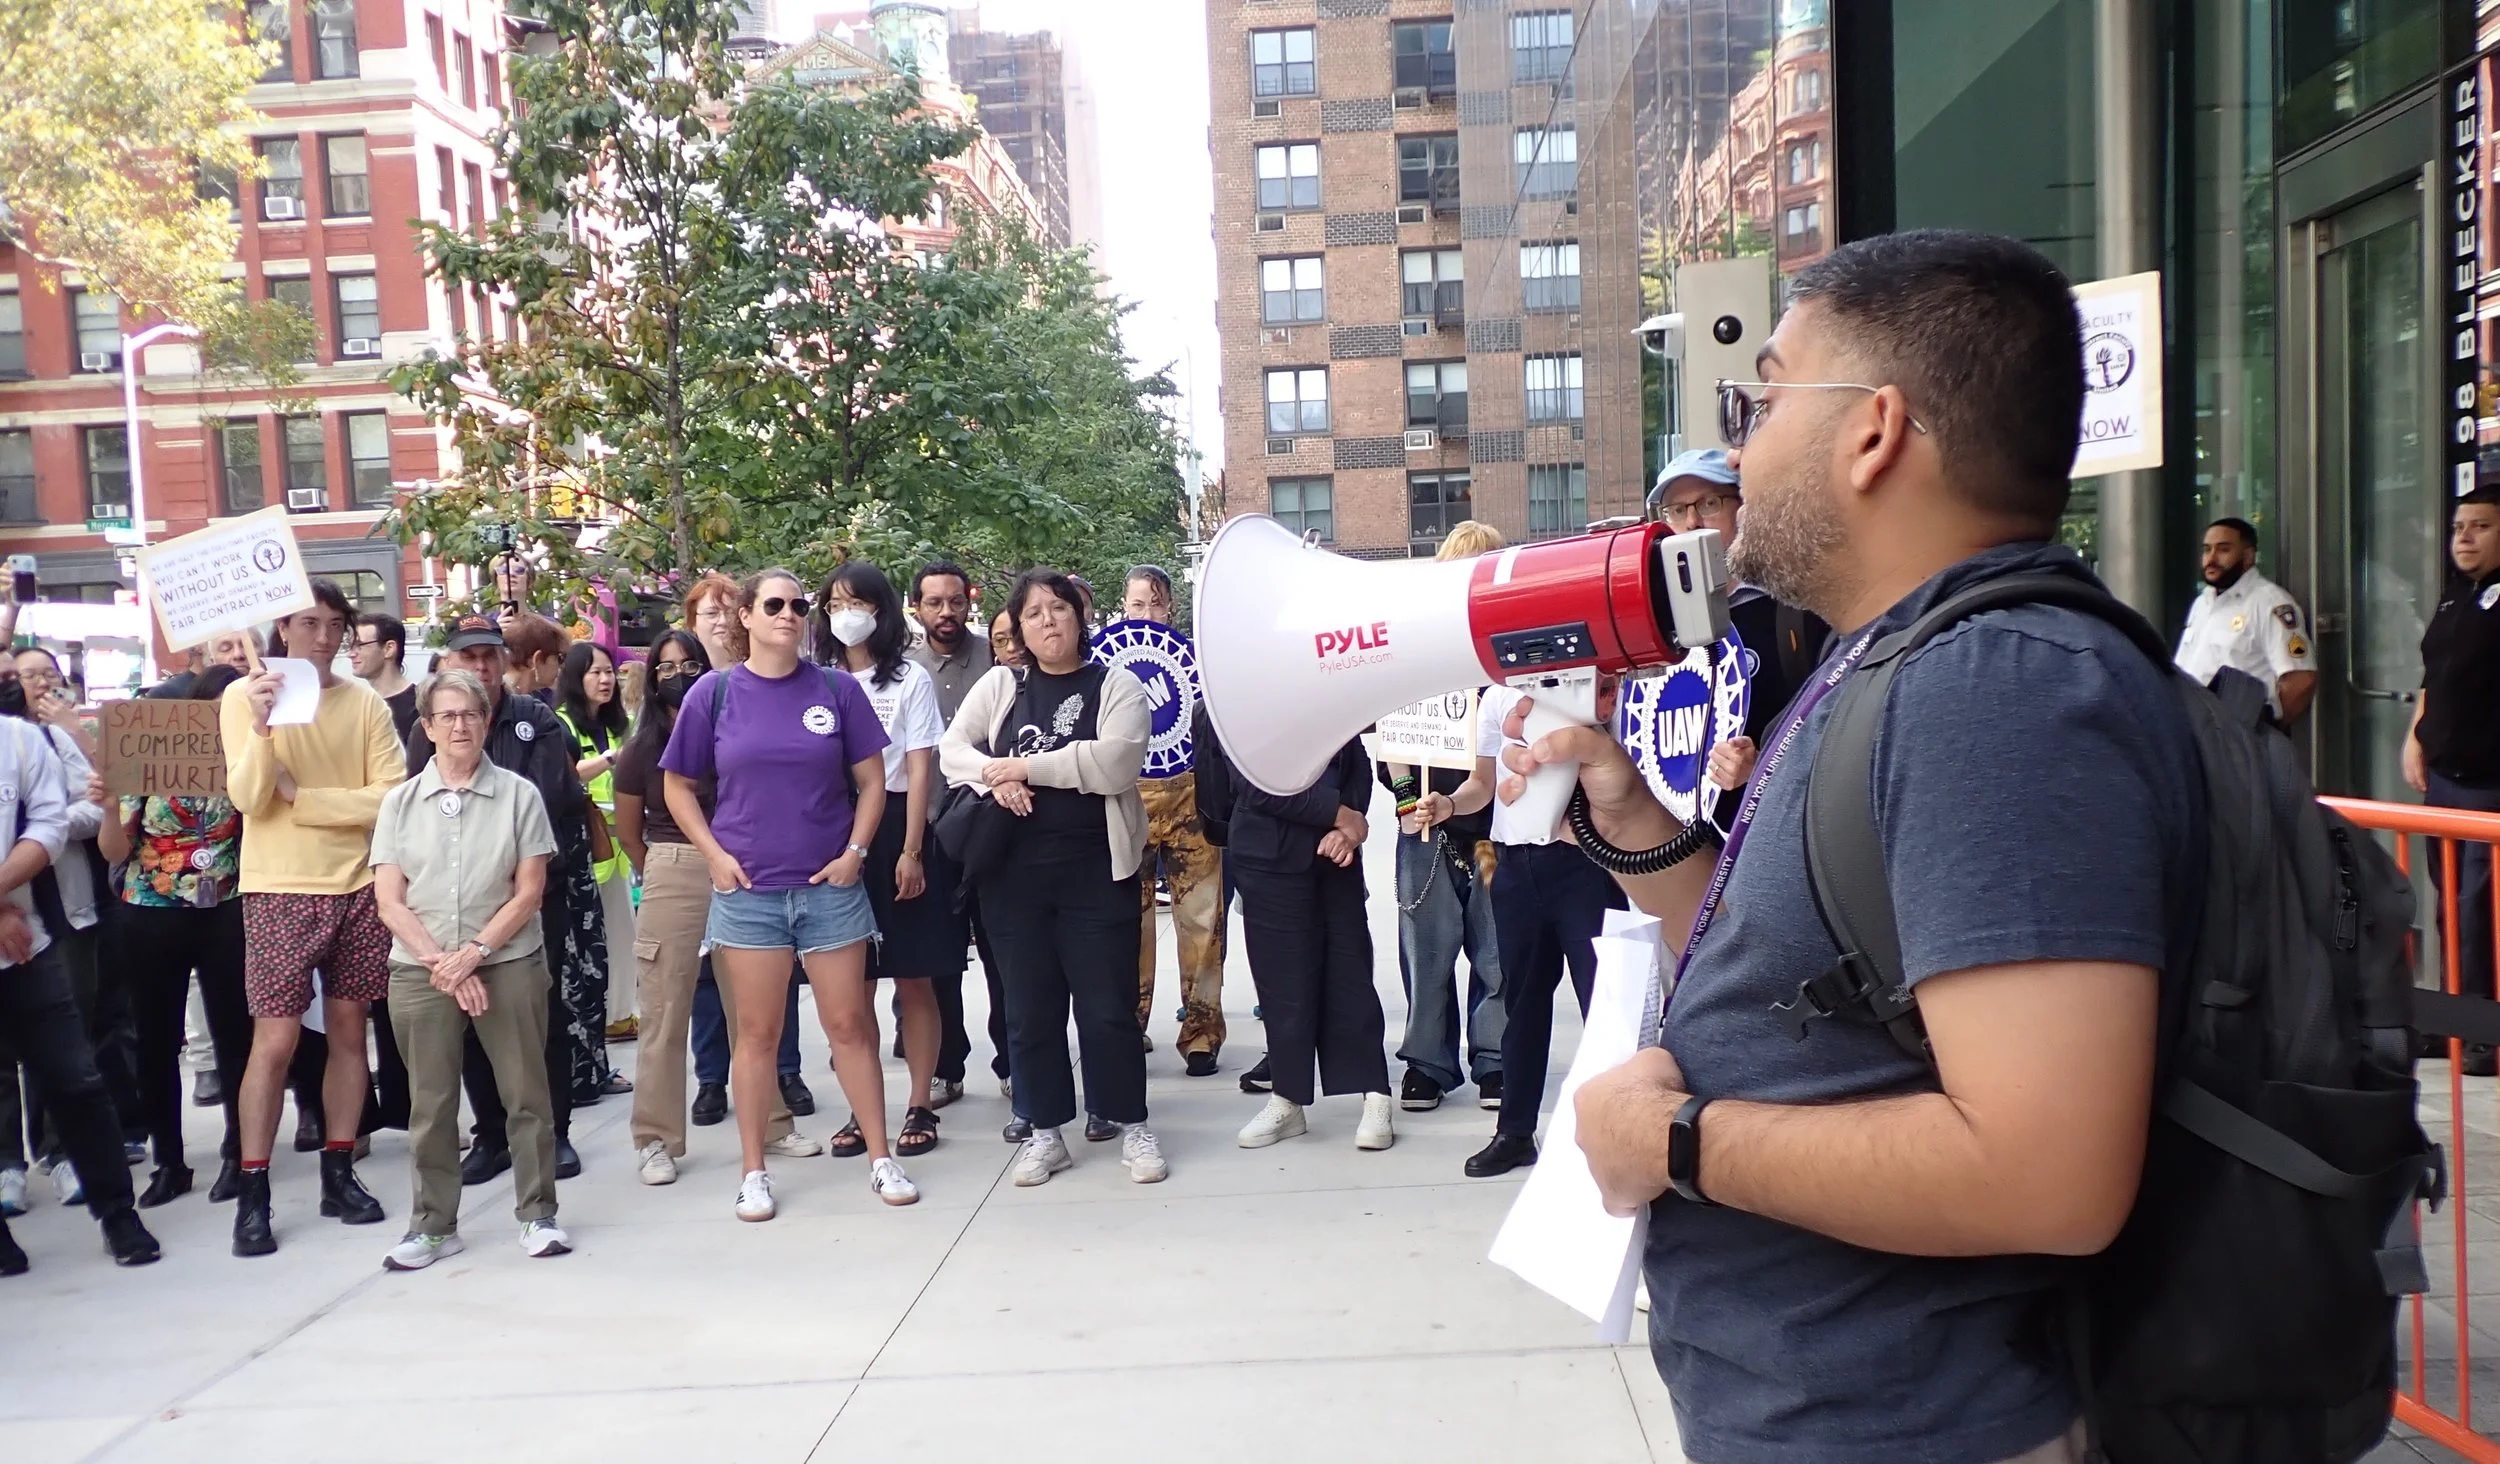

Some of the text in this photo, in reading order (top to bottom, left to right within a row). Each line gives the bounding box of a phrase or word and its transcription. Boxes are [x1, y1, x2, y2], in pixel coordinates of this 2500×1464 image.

[2456, 75, 2476, 444] 98 BLEECKER
[154, 574, 174, 587] NYU
[179, 561, 207, 580] CAN'T
[213, 552, 242, 568] WORK
[159, 572, 225, 604] WITHOUT
[170, 615, 195, 632] FAIR
[199, 594, 261, 622] CONTRACT
[1315, 621, 1389, 658] PYLE
[1319, 652, 1393, 676] PyleUSA.com
[1826, 660, 1848, 686] NEW
[1124, 648, 1146, 659] UNITED
[1148, 728, 1185, 749] AGRICULTURA
[1142, 671, 1172, 711] AW
[109, 702, 221, 731] SALARY
[1390, 720, 1409, 728] DESERVE
[1411, 722, 1420, 730] AND
[1421, 722, 1442, 731] DEMAND
[1658, 702, 1709, 759] UAW
[120, 733, 224, 758] COMPRES
[1381, 731, 1397, 743] FAIR
[1399, 732, 1440, 747] CONTRACT
[1740, 715, 1805, 824] NEW YORK UNIVERSITY
[1687, 855, 1734, 955] NEW YORK UNIVERSITY
